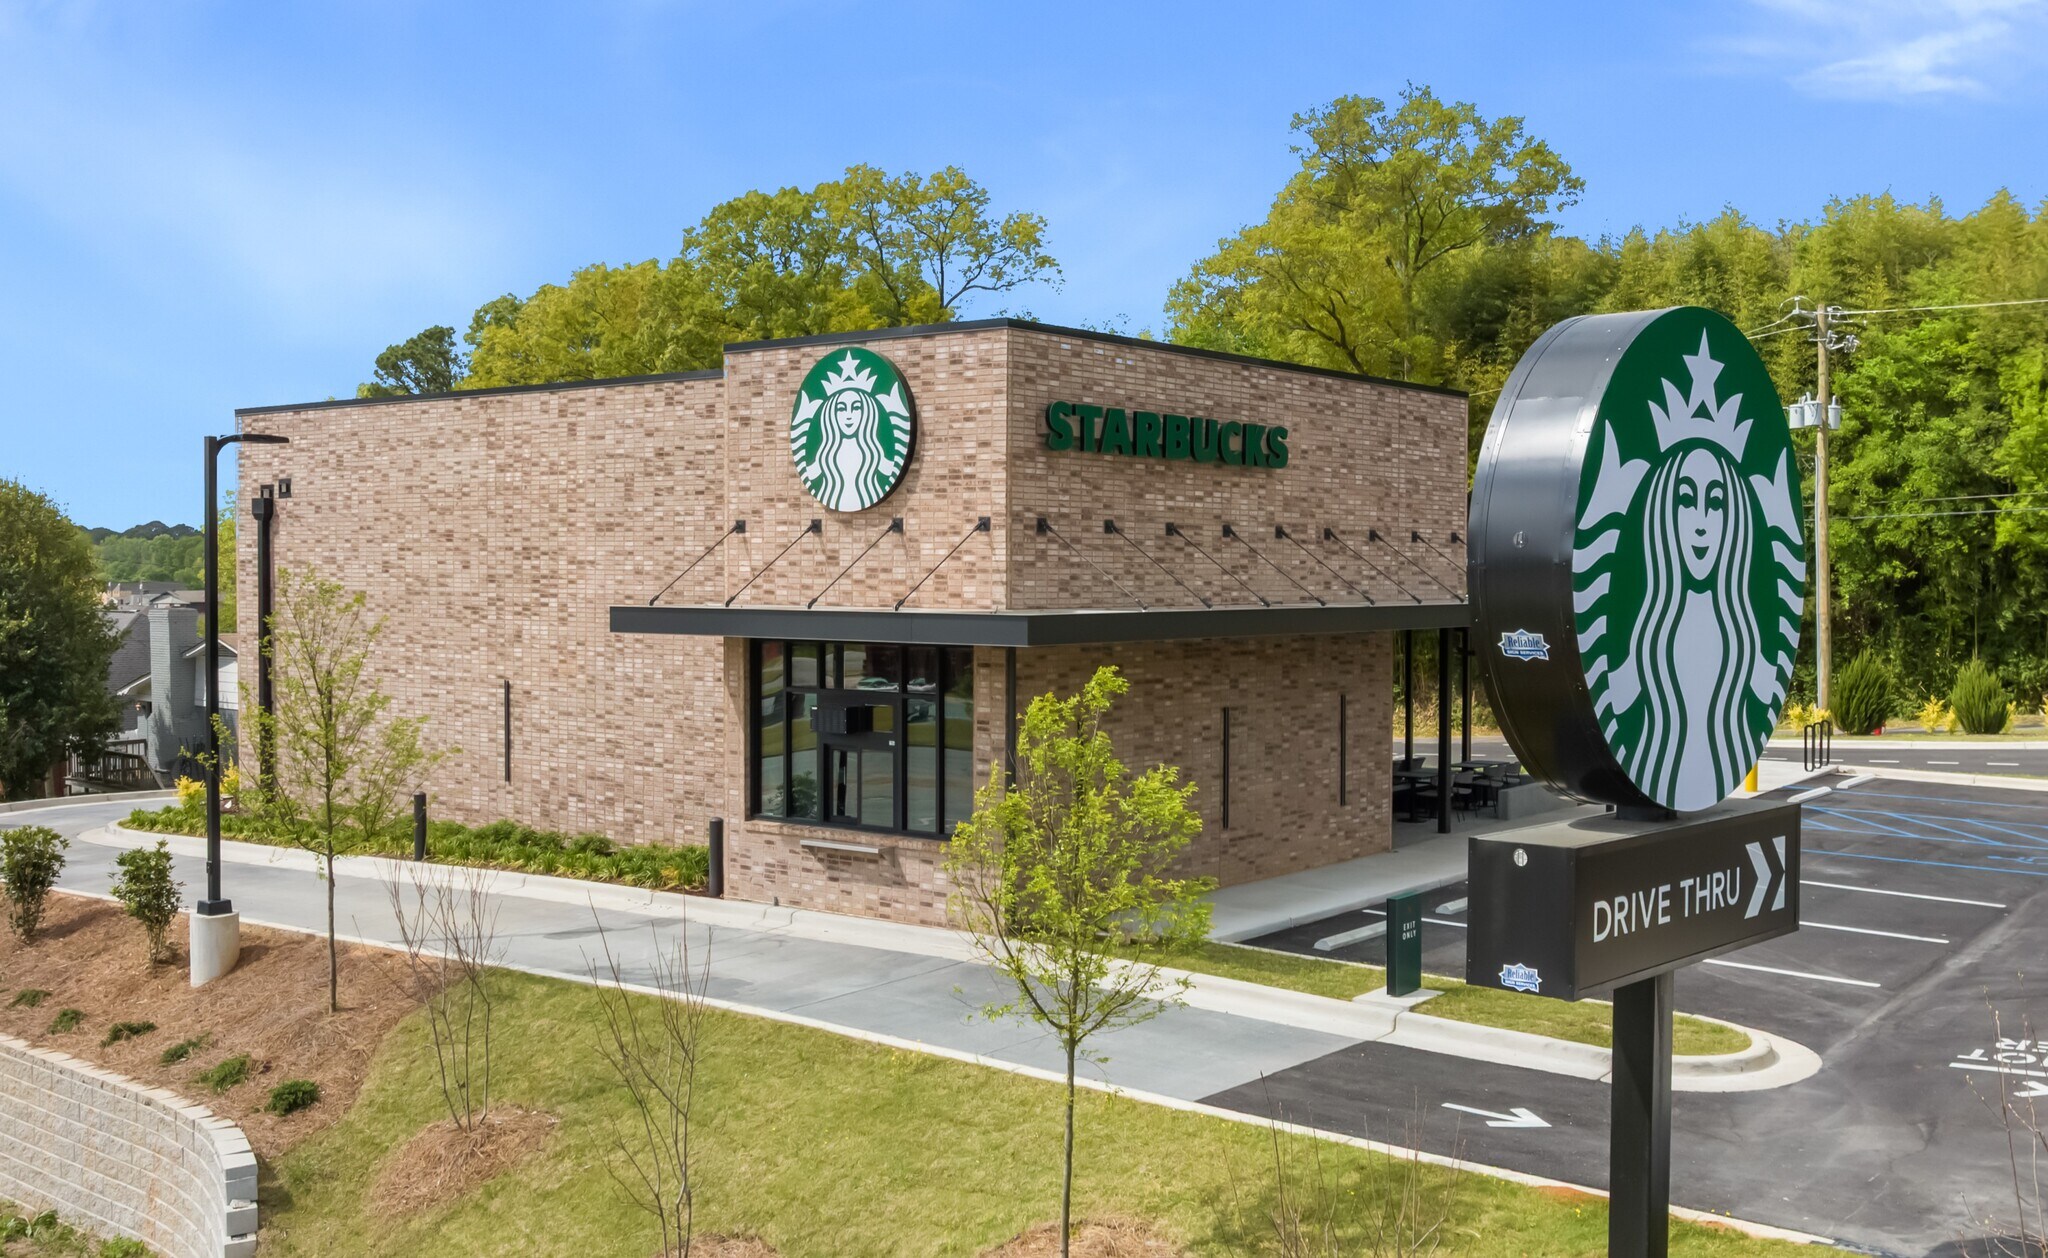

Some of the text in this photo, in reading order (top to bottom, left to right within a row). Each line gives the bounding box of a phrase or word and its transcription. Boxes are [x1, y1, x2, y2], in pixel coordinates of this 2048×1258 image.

[1046, 400, 1289, 469] STARBUCKS
[1507, 636, 1541, 648] Reliable
[1593, 866, 1741, 943] DRIVE THRU
[1403, 921, 1416, 931] EXIT
[1402, 929, 1417, 940] ONLY
[1507, 968, 1535, 981] Reliable
